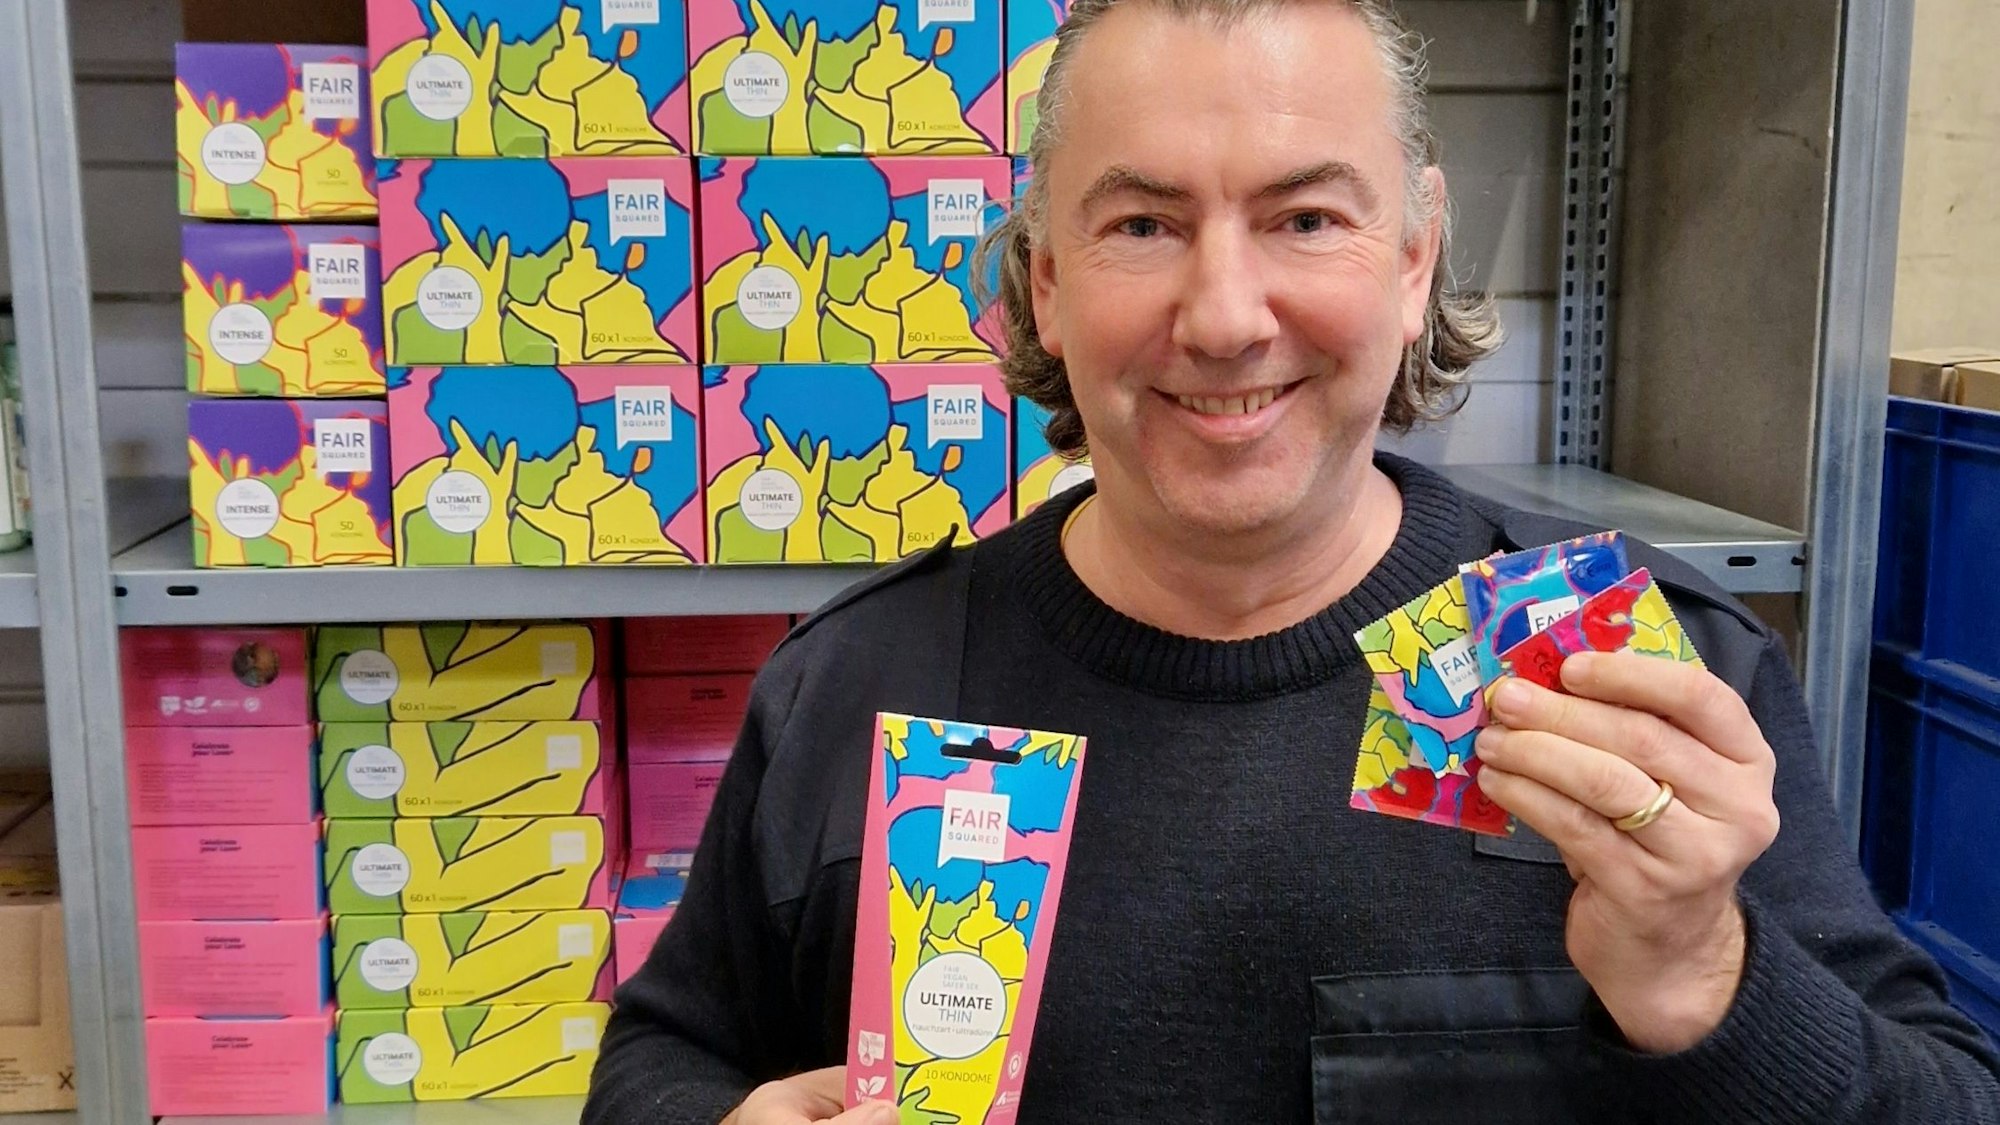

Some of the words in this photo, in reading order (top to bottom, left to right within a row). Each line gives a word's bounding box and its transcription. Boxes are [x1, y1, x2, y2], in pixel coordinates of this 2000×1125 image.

[309, 77, 354, 96] FAIR
[416, 80, 464, 90] ULTIMATE
[734, 78, 780, 87] ULTIMATE
[584, 124, 598, 133] 60
[897, 121, 911, 131] 60
[211, 149, 257, 161] INTENSE
[615, 194, 659, 210] FAIR
[934, 194, 977, 210] FAIR
[616, 215, 659, 223] SQUARED
[315, 258, 359, 273] FAIR
[427, 292, 473, 301] ULTIMATE
[746, 291, 792, 300] ULTIMATE
[219, 331, 264, 340] INTENSE
[591, 333, 606, 343] 60
[908, 332, 922, 342] 60
[622, 400, 666, 416] FAIR
[934, 399, 977, 414] FAIR
[934, 418, 977, 426] SQUARED
[321, 433, 365, 448] FAIR
[436, 496, 482, 504] ULTIMATE
[749, 494, 795, 502] ULTIMATE
[226, 506, 271, 514] INTENSE
[599, 535, 613, 545] 60
[907, 532, 922, 542] 60
[348, 671, 391, 679] ULTIMATE
[399, 703, 413, 711] 60
[355, 766, 397, 774] ULTIMATE
[405, 797, 419, 805] 60
[949, 807, 1002, 830] FAIR
[948, 832, 999, 845] SQUARED
[360, 864, 403, 872] ULTIMATE
[410, 894, 424, 902] 60
[368, 958, 410, 966] ULTIMATE
[943, 973, 968, 982] VEGAN
[418, 988, 432, 996] 60
[920, 991, 993, 1011] ULTIMATE
[938, 1008, 973, 1025] THIN
[372, 1052, 414, 1060] ULTIMATE
[926, 1069, 939, 1080] 10
[940, 1071, 993, 1084] KONDOME
[421, 1082, 435, 1090] 60
